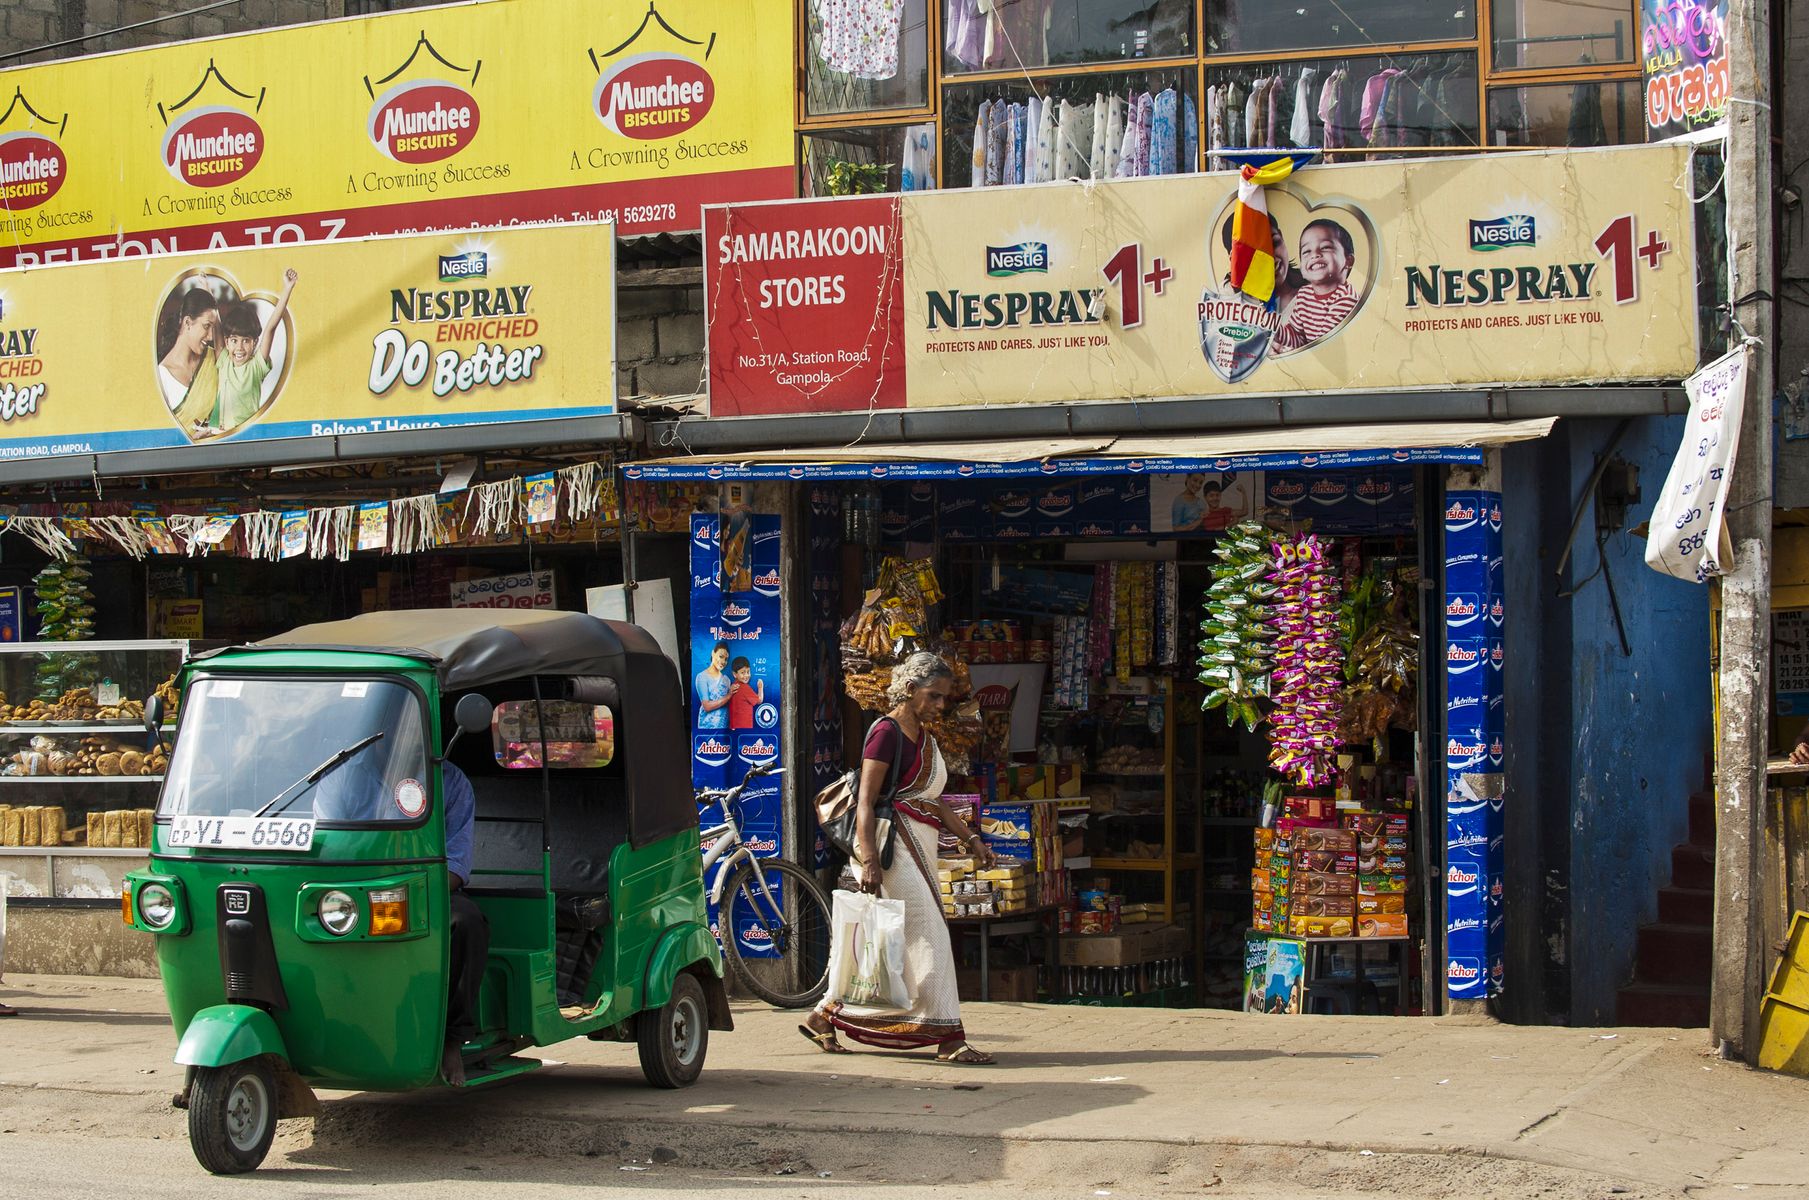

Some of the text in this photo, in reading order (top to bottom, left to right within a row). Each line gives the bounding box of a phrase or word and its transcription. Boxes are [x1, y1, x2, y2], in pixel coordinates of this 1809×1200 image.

[611, 76, 704, 112] Munchee
[386, 102, 470, 136] Munchee
[624, 108, 691, 128] BISCUITS
[175, 127, 255, 161] Munchee
[397, 134, 458, 152] BISCUITS
[570, 140, 748, 170] A Crowning Success
[0, 152, 59, 184] unchee
[187, 158, 244, 176] BISCUITS
[347, 162, 511, 193] A Crowning Success
[143, 185, 292, 216] A Crowning Success
[38, 210, 93, 228] Success
[598, 208, 619, 224] 081
[624, 204, 676, 224] 5629278
[245, 224, 305, 246] TO
[718, 226, 884, 264] SAMARAKOON
[760, 276, 846, 308] STORES
[1404, 262, 1596, 310] NESPRAY
[390, 285, 532, 324] NESPRAY
[926, 288, 1104, 330] NESPRAY
[1198, 302, 1281, 332] PROTECTION
[1405, 312, 1604, 332] PROTECTS AND CARES. JUST LIKE YOU.
[436, 320, 538, 342] ENRICHED
[926, 336, 1110, 353] PROTECTS AND CARES. JUST LIKE YOU.
[368, 328, 542, 396] Do Better
[792, 350, 829, 364] Station
[26, 446, 50, 456] ROAD,
[51, 444, 92, 454] GAMPOLA.
[723, 606, 750, 616] Anchor
[1447, 648, 1476, 660] nchor
[1780, 654, 1802, 664] 14 15
[1781, 667, 1802, 676] 21 22
[1780, 679, 1803, 689] 28 29
[978, 691, 1007, 706] TIARA
[1447, 743, 1475, 756] nchor
[171, 830, 190, 844] CP
[1448, 870, 1477, 882] nchor
[1448, 965, 1477, 978] nchor
